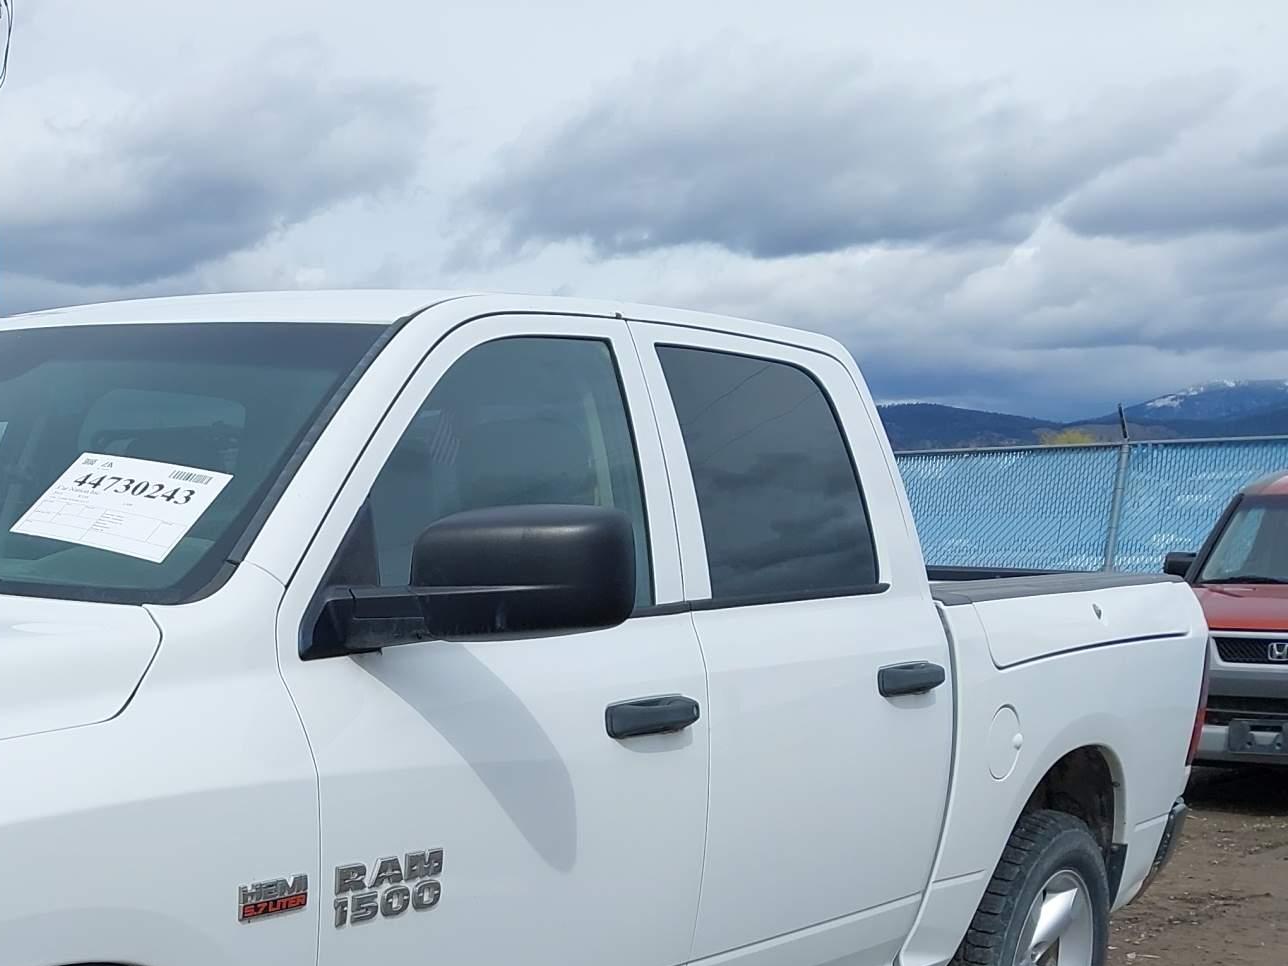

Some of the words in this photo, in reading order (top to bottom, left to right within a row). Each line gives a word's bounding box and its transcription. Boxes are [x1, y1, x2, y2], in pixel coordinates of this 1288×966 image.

[74, 472, 196, 505] 44730243
[335, 847, 444, 896] RAM
[239, 873, 308, 905] HEMI
[243, 902, 268, 917] 5.7
[268, 893, 306, 913] LITER
[333, 879, 442, 929] 1500
